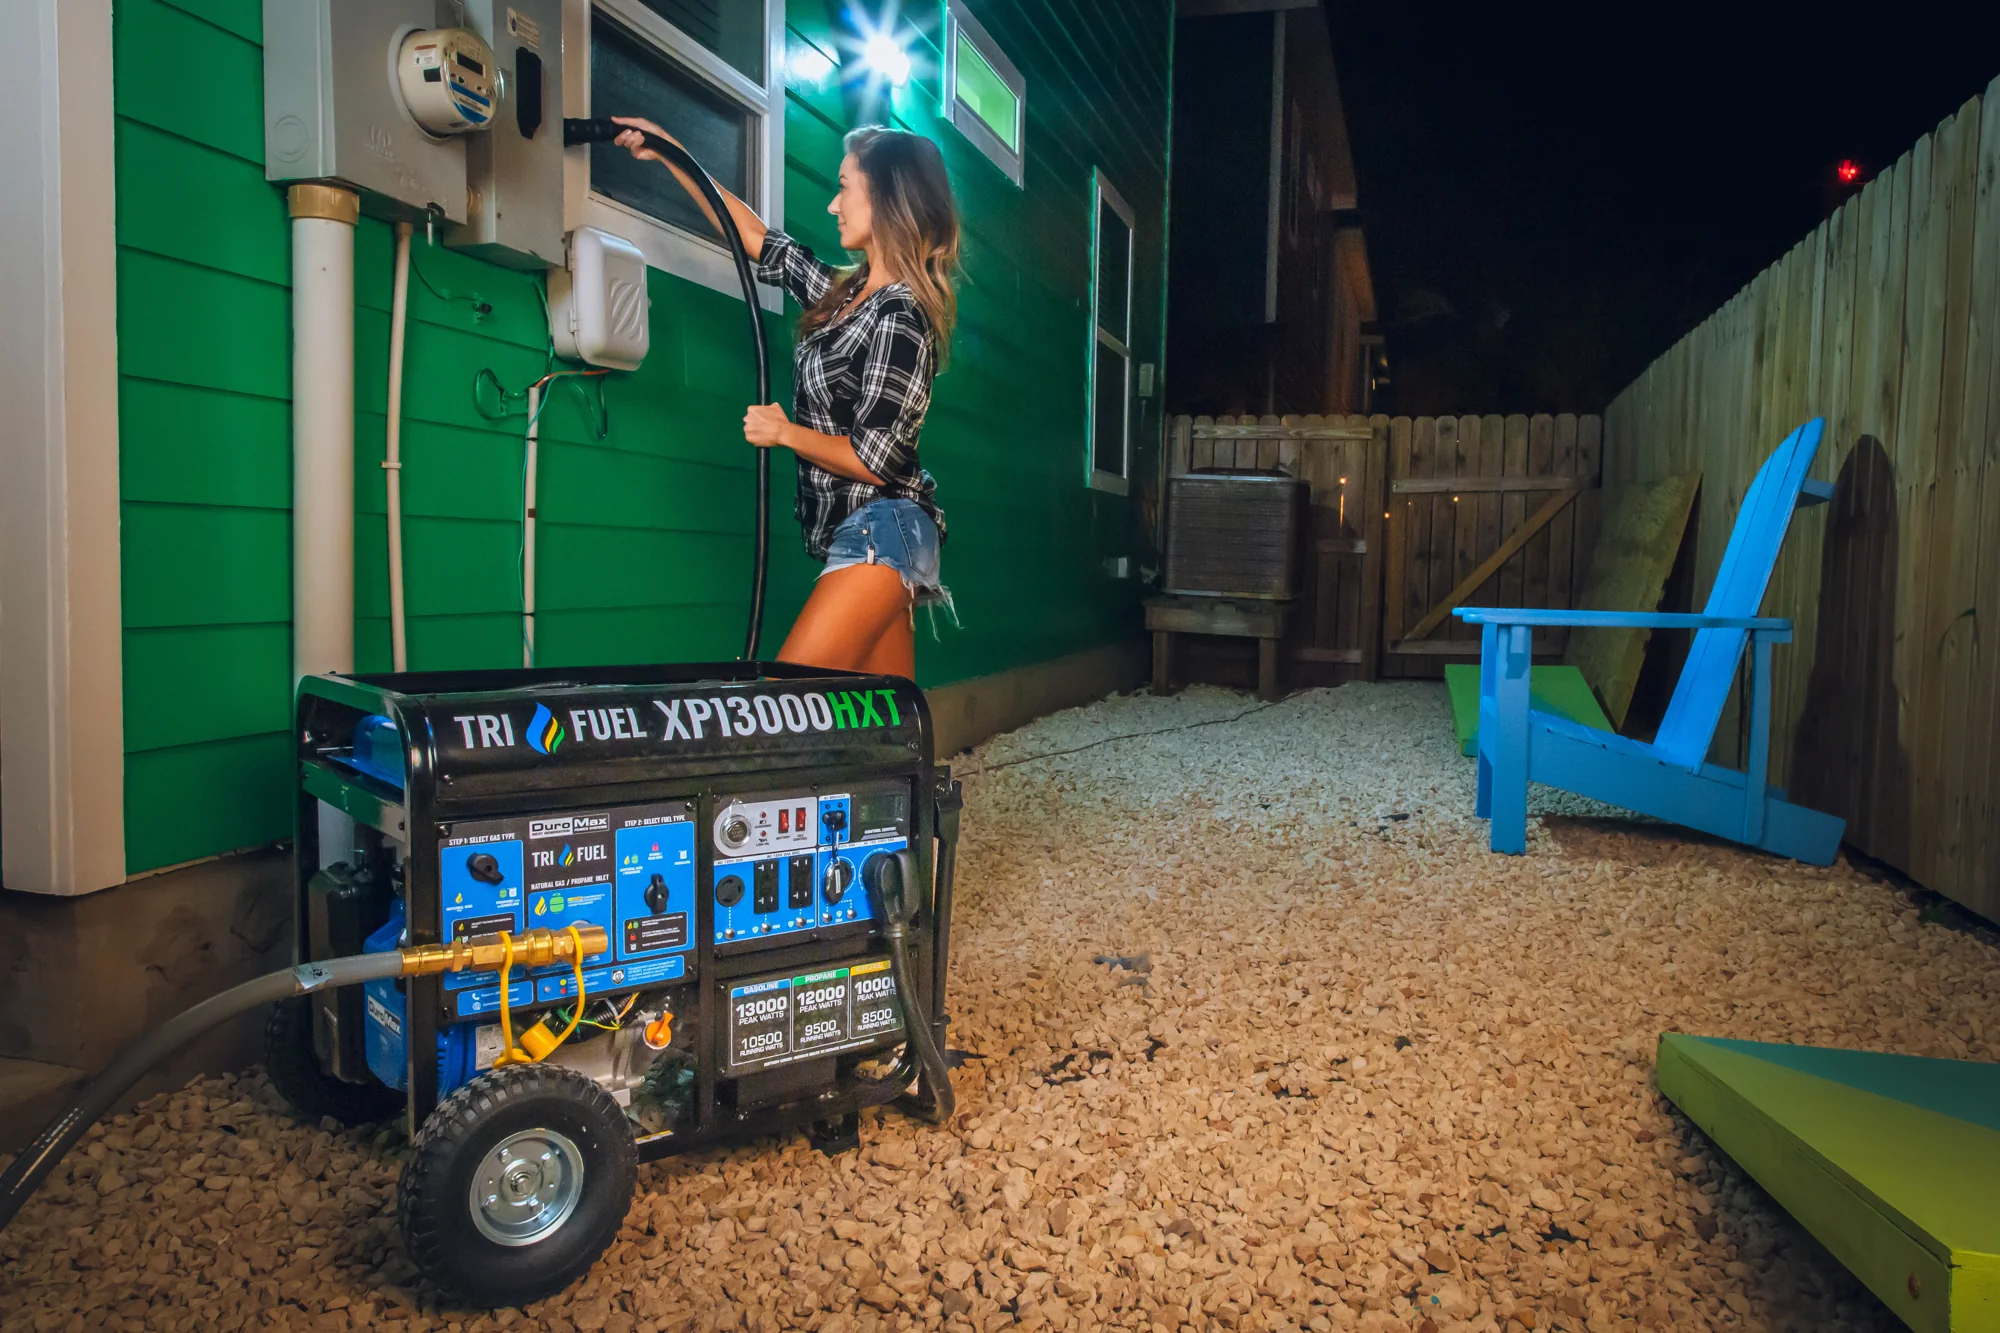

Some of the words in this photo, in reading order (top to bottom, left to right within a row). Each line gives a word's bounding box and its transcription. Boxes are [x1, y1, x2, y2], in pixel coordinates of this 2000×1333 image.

[453, 713, 515, 749] TRI
[569, 707, 648, 742] FUEL
[652, 689, 901, 741] XP13000HXT
[643, 817, 660, 825] SELECT
[449, 838, 463, 846] STEP
[469, 835, 489, 844] SELECT
[490, 834, 501, 842] GAS
[502, 832, 516, 840] TYPE
[531, 850, 555, 868] TRI
[577, 844, 607, 862] FUEL
[530, 881, 555, 891] NATURAL
[555, 880, 566, 888] GAS
[571, 876, 594, 885] PROPANE
[595, 874, 609, 882] INLET
[805, 971, 837, 983] PROPANE
[743, 982, 779, 994] GASOLINE
[796, 984, 846, 1006] 12000
[856, 991, 876, 1003] PEAK
[735, 997, 787, 1018] 13000
[799, 1003, 818, 1014] PEAK
[818, 999, 843, 1010] WATTS
[738, 1015, 759, 1026] PEAK
[759, 1010, 785, 1022] WATTS
[861, 1007, 893, 1025] 8500
[804, 1019, 837, 1037] 9500
[857, 1021, 880, 1032] RUNNING
[879, 1017, 897, 1027] WATTS
[741, 1031, 782, 1050] 10500
[800, 1033, 824, 1044] RUNNING
[823, 1029, 842, 1039] WATTS
[739, 1047, 764, 1057] RUNNING
[765, 1041, 784, 1052] WATTS
